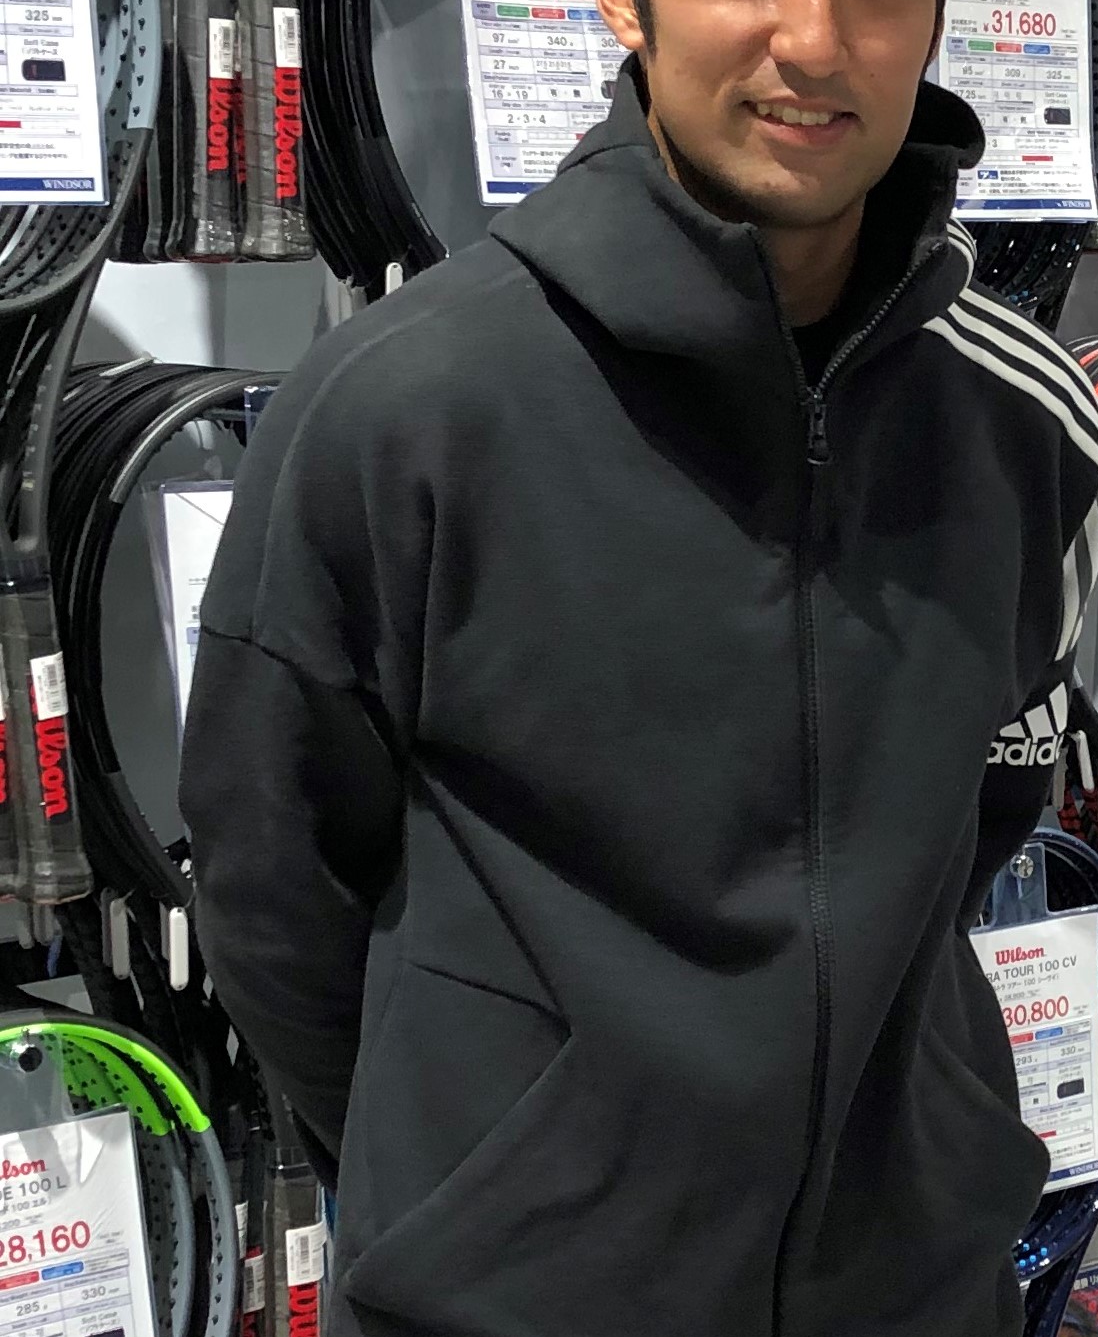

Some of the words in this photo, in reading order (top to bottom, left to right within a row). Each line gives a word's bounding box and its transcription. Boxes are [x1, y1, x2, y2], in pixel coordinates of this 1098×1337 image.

[24, 9, 50, 22] 325
[492, 33, 505, 43] 97
[547, 36, 568, 46] 340
[493, 59, 506, 70] 27
[208, 77, 231, 172] ilson
[42, 178, 94, 191] WINDSOR
[987, 733, 1065, 766] adid
[995, 947, 1047, 966] Wilson
[1004, 964, 1034, 980] TOUR
[1039, 959, 1059, 973] 100
[1062, 955, 1077, 968] CV
[0, 1159, 47, 1180] lson
[19, 1178, 52, 1197] 100
[56, 1176, 67, 1189] L
[16, 1301, 40, 1317] 285
[81, 1285, 106, 1301] 330
